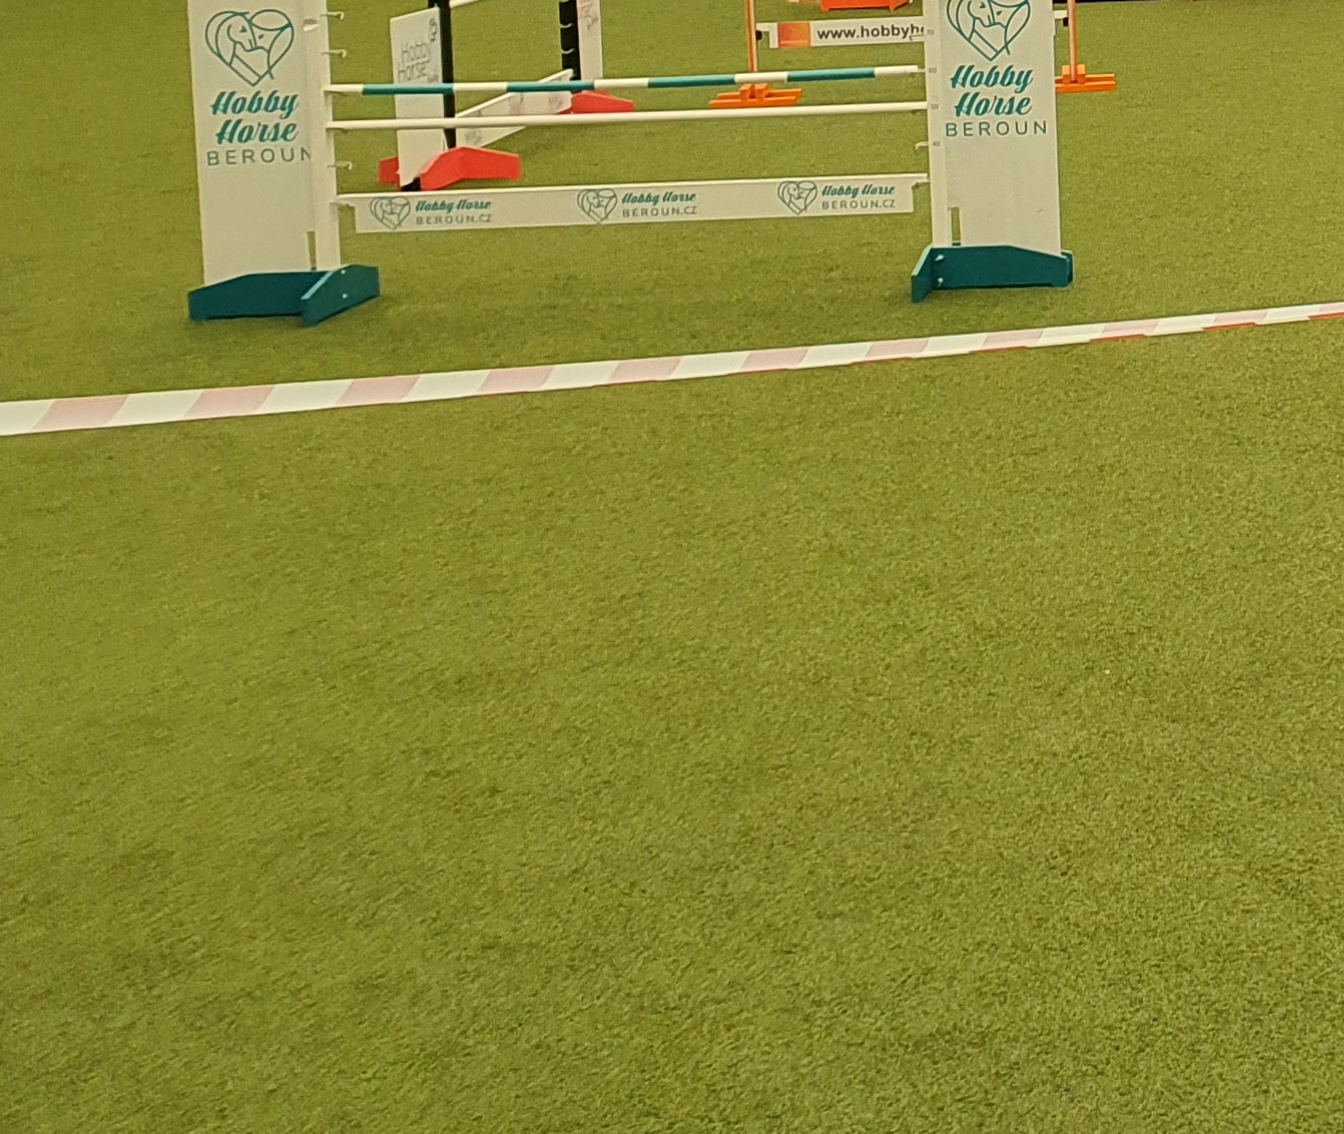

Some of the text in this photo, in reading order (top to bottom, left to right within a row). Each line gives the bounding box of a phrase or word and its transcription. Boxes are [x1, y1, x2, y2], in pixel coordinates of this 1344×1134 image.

[817, 23, 924, 39] www.hobbyh
[950, 64, 1034, 94] Hobby
[210, 89, 299, 119] Hobby
[954, 92, 1032, 117] Horse
[215, 119, 298, 144] Horse
[945, 120, 1047, 137] BEROUN
[622, 191, 696, 206] Hobby Horse
[822, 184, 896, 198] Hobby Horse
[416, 199, 492, 213] Hobby Horse
[622, 206, 698, 218] BEROUN.CZ
[821, 199, 896, 210] BEROUN.CZ
[416, 213, 492, 225] BEROUN.CZ
